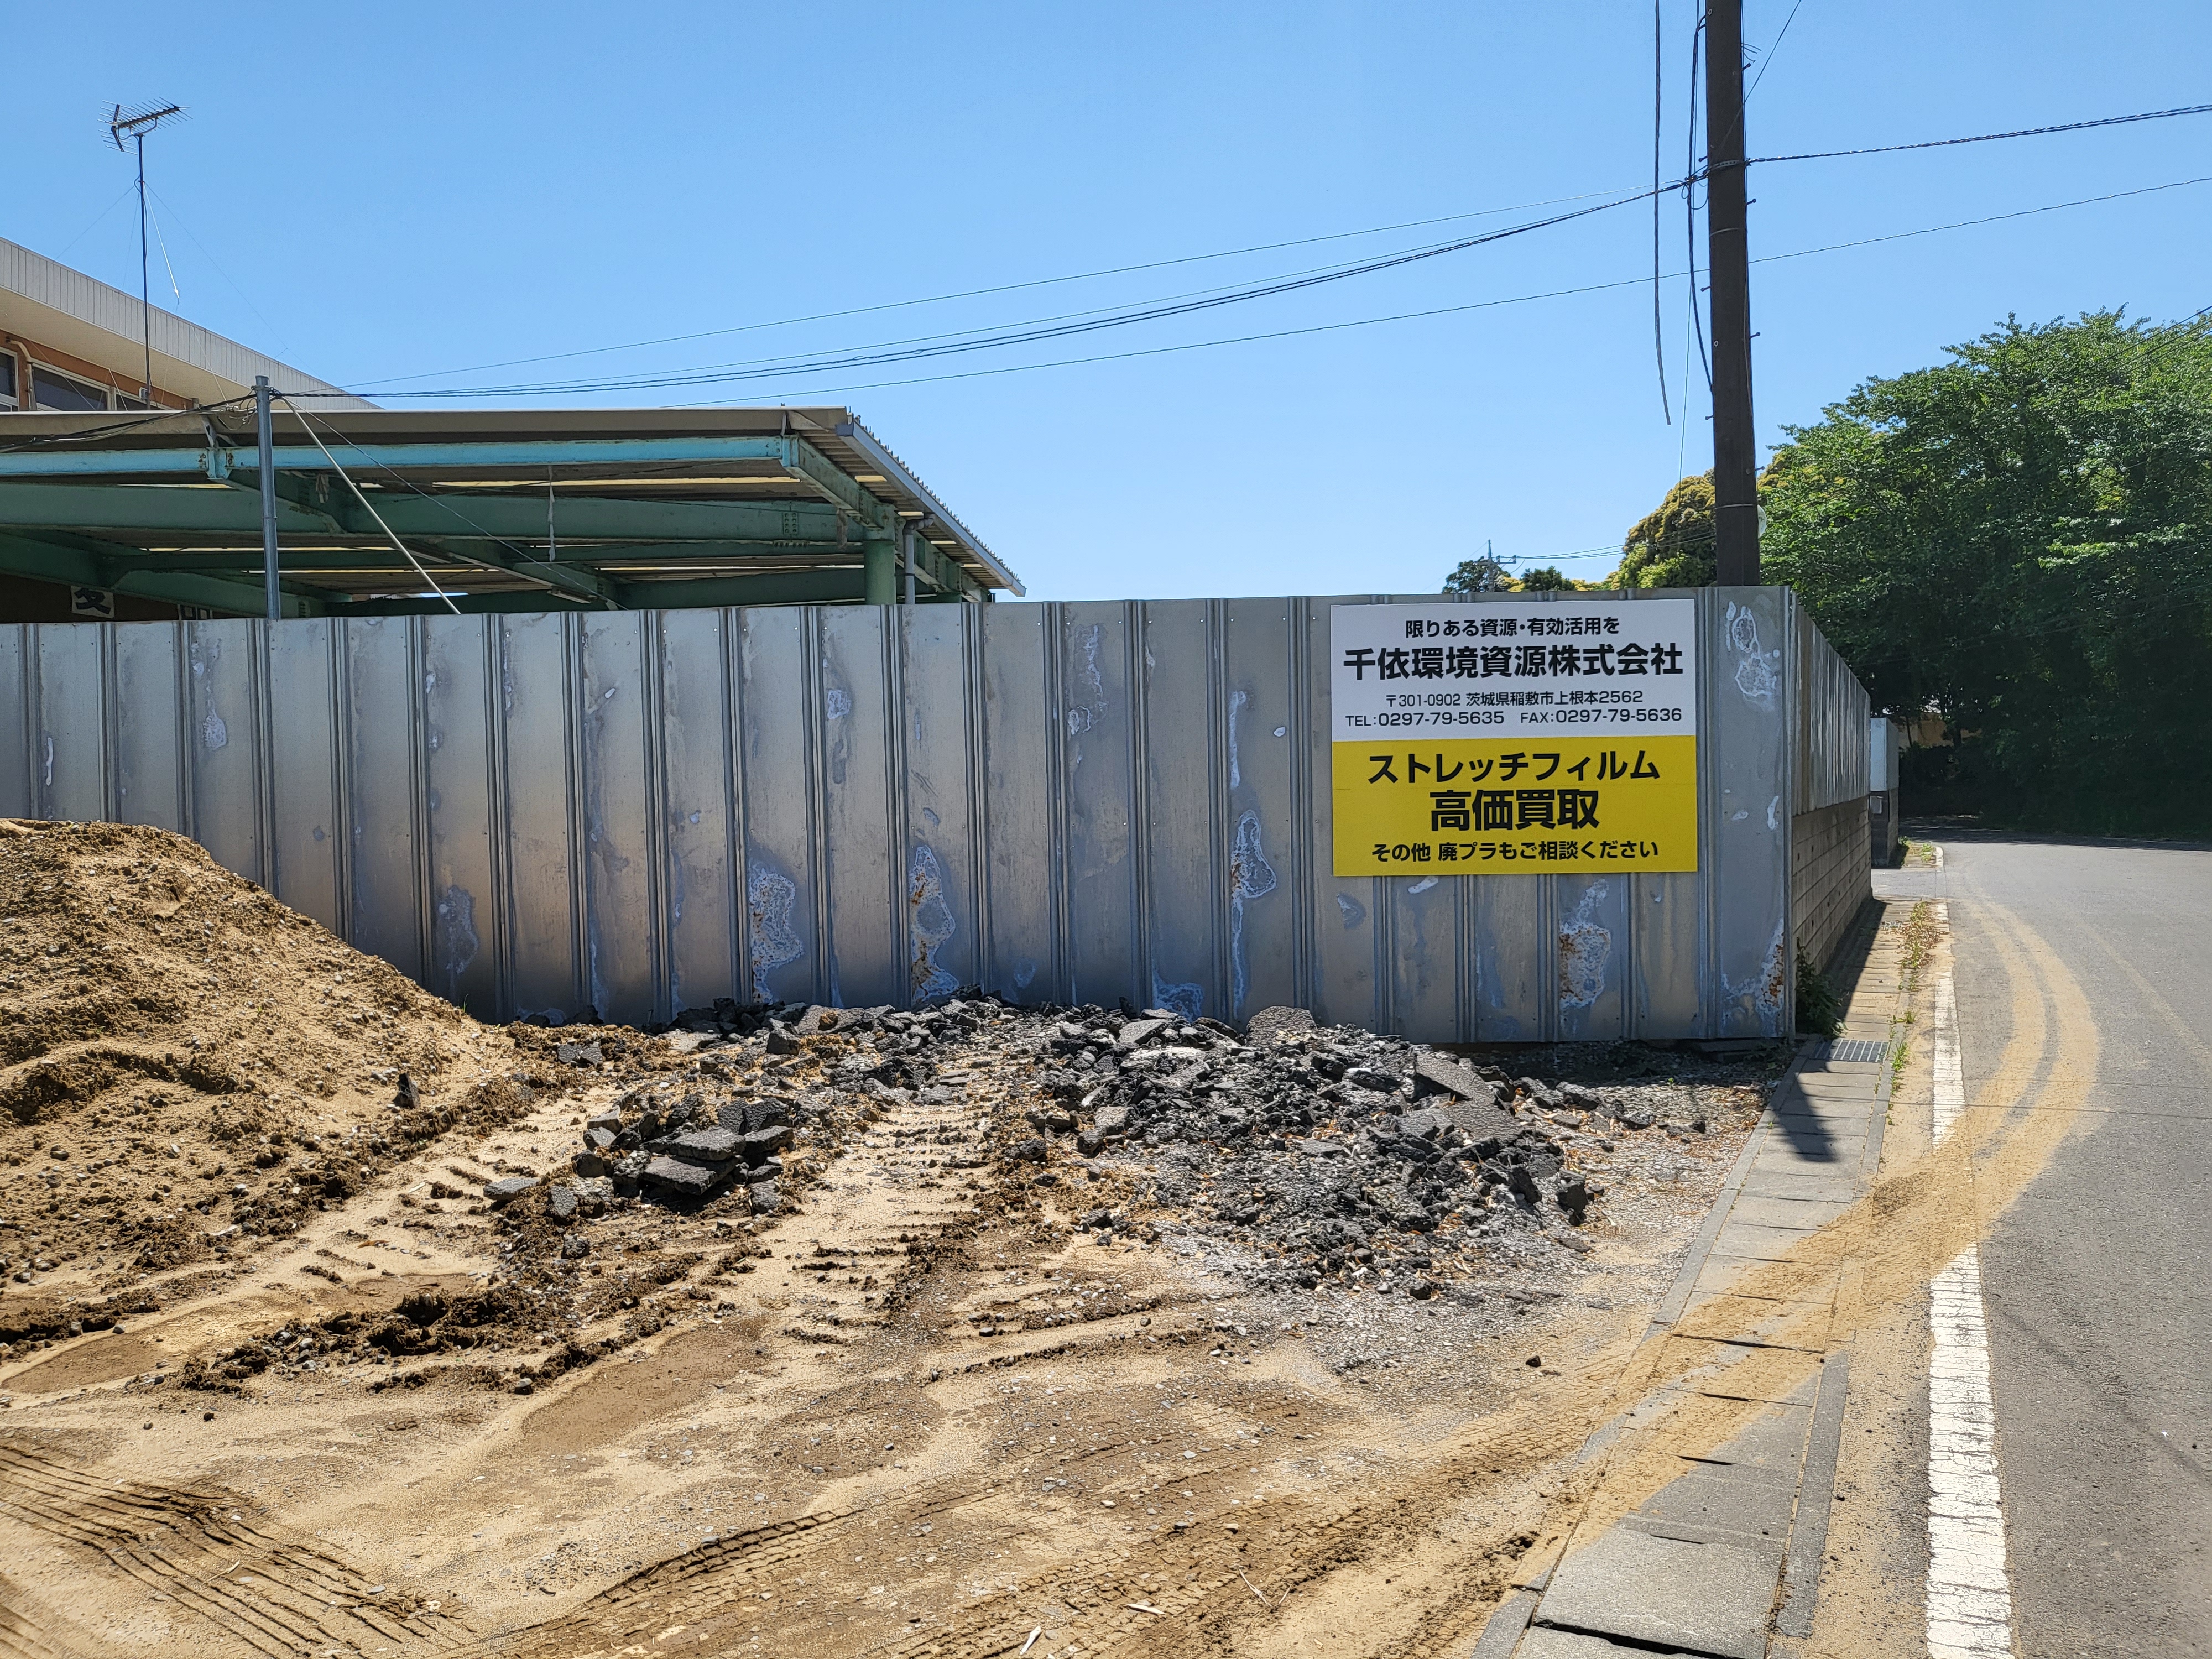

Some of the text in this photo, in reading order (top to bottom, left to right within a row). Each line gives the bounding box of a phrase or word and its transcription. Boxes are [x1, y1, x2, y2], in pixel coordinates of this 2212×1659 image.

[1405, 617, 1620, 639] 限りある資源・有効活用を
[1343, 643, 1683, 681] 千依環境資源株式会社
[1465, 690, 1643, 707] 茨城県稲敷市上根本2562
[1368, 750, 1661, 784] ストレッチフィルム
[1429, 789, 1600, 832] 高価買取
